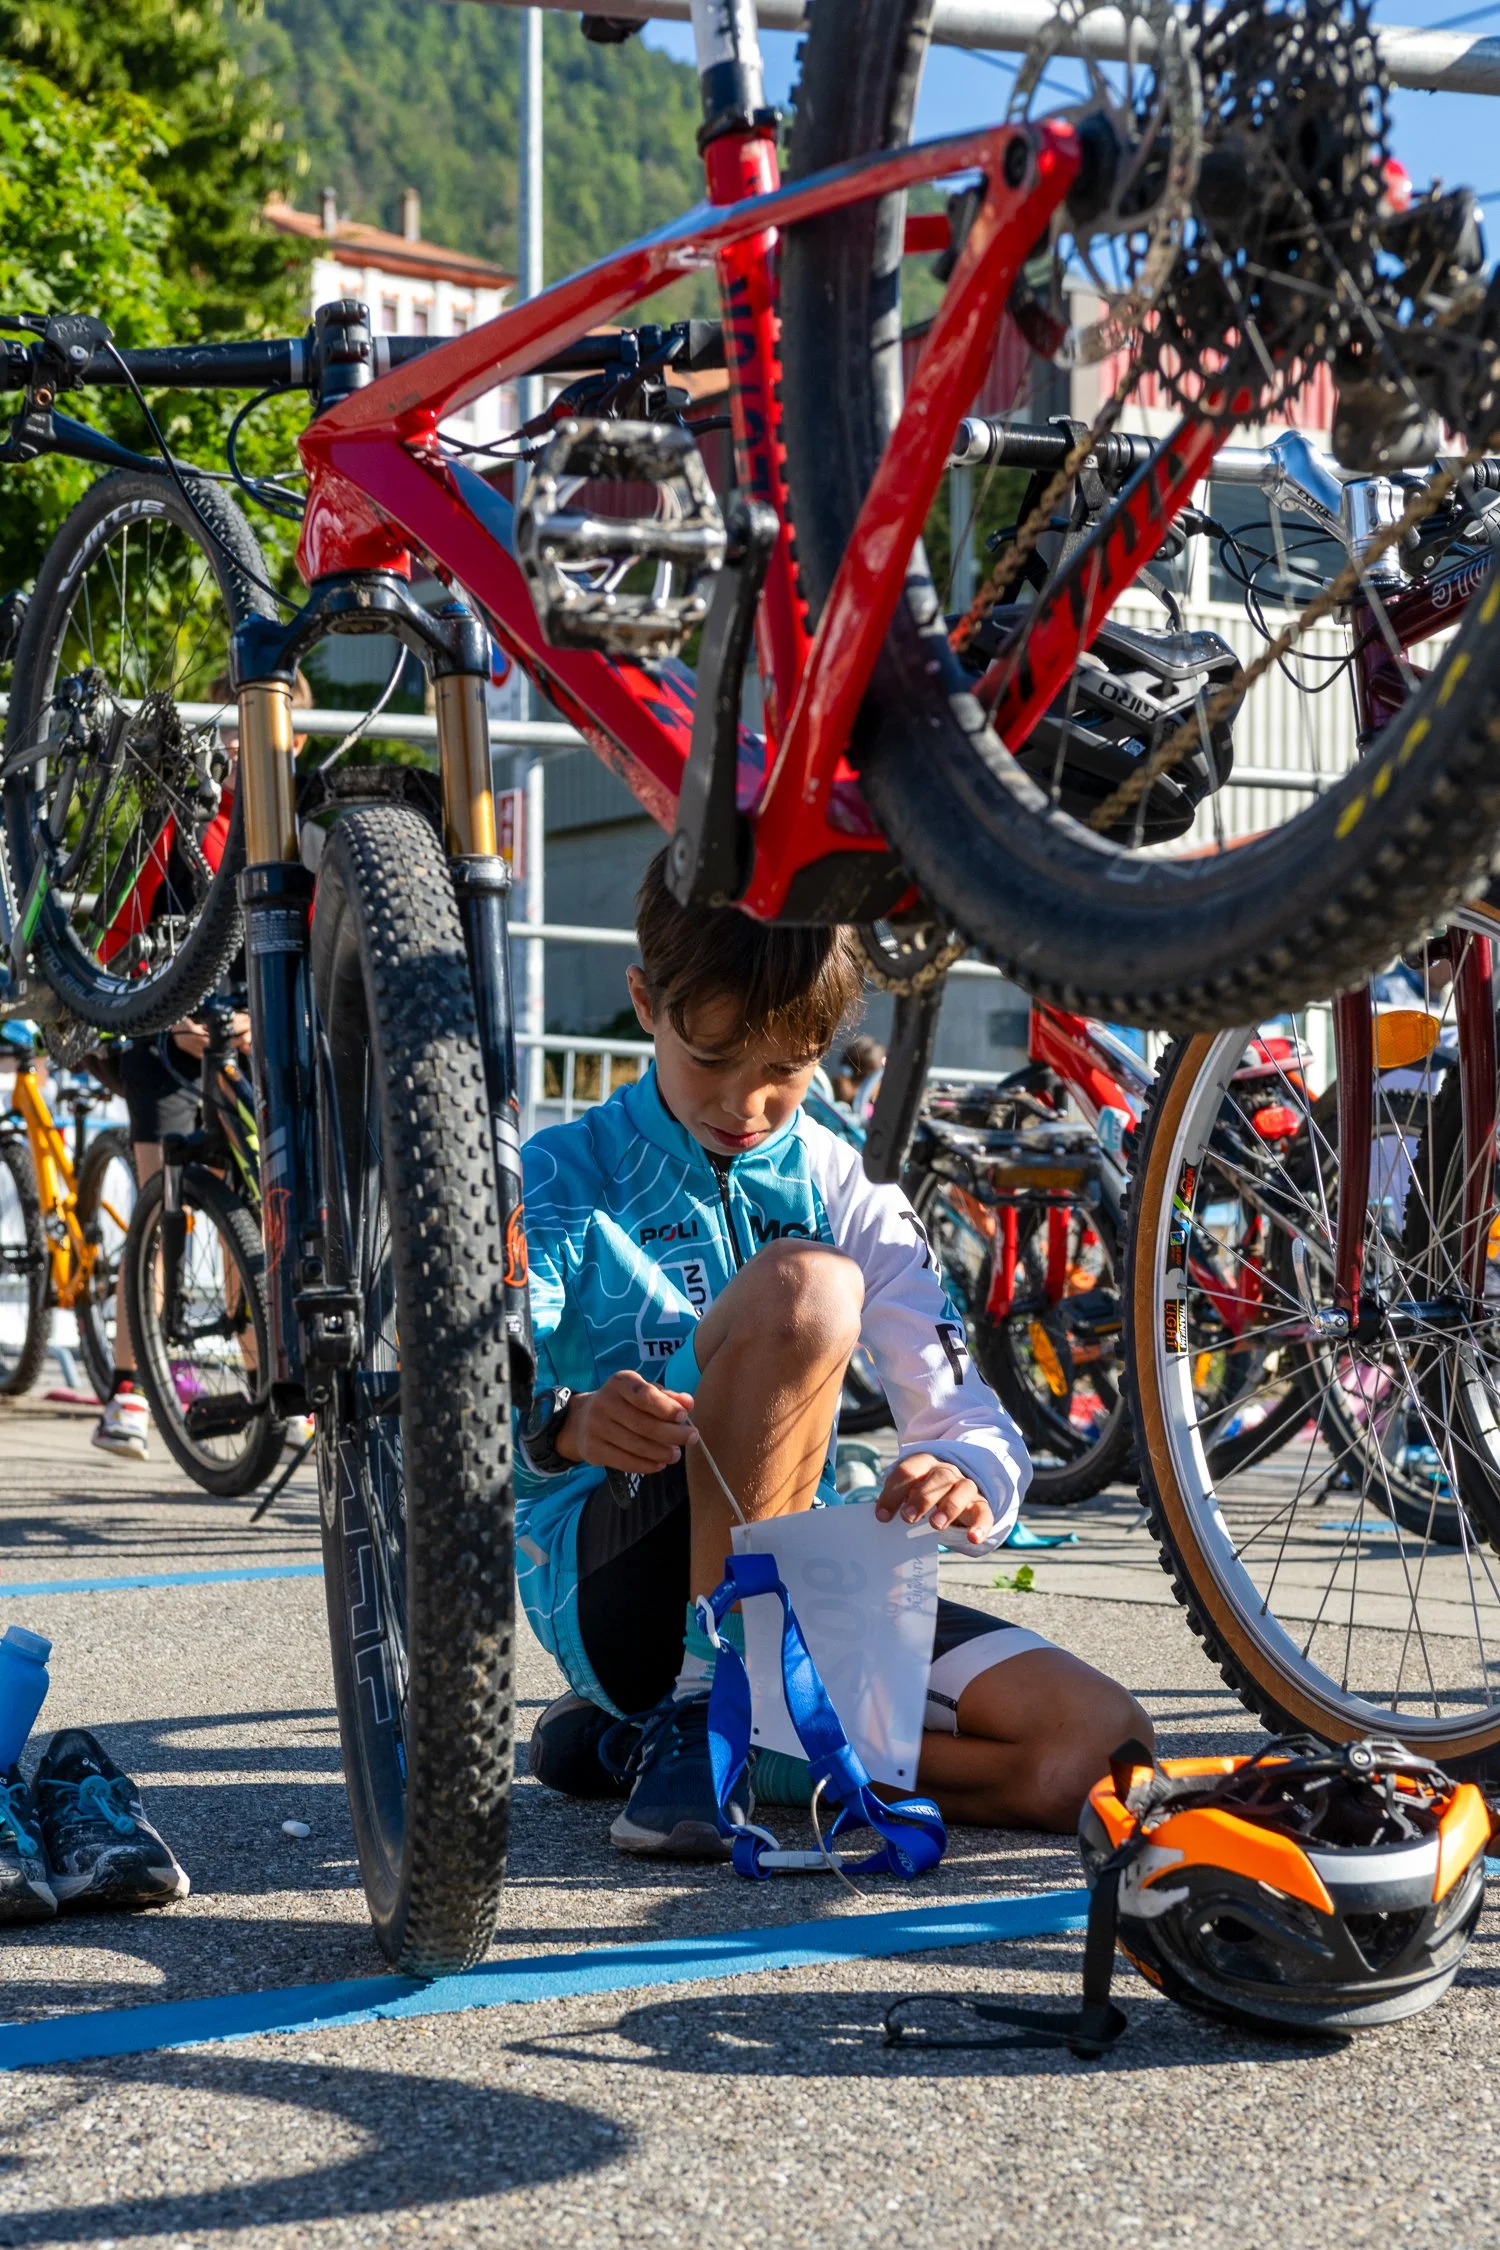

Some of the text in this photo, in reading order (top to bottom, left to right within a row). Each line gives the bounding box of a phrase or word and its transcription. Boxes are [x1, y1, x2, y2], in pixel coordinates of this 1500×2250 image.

[1296, 488, 1331, 519] EXTRA
[1098, 680, 1161, 723] GIRO
[639, 1220, 699, 1246] POLI
[1165, 1302, 1177, 1348] LIGHT
